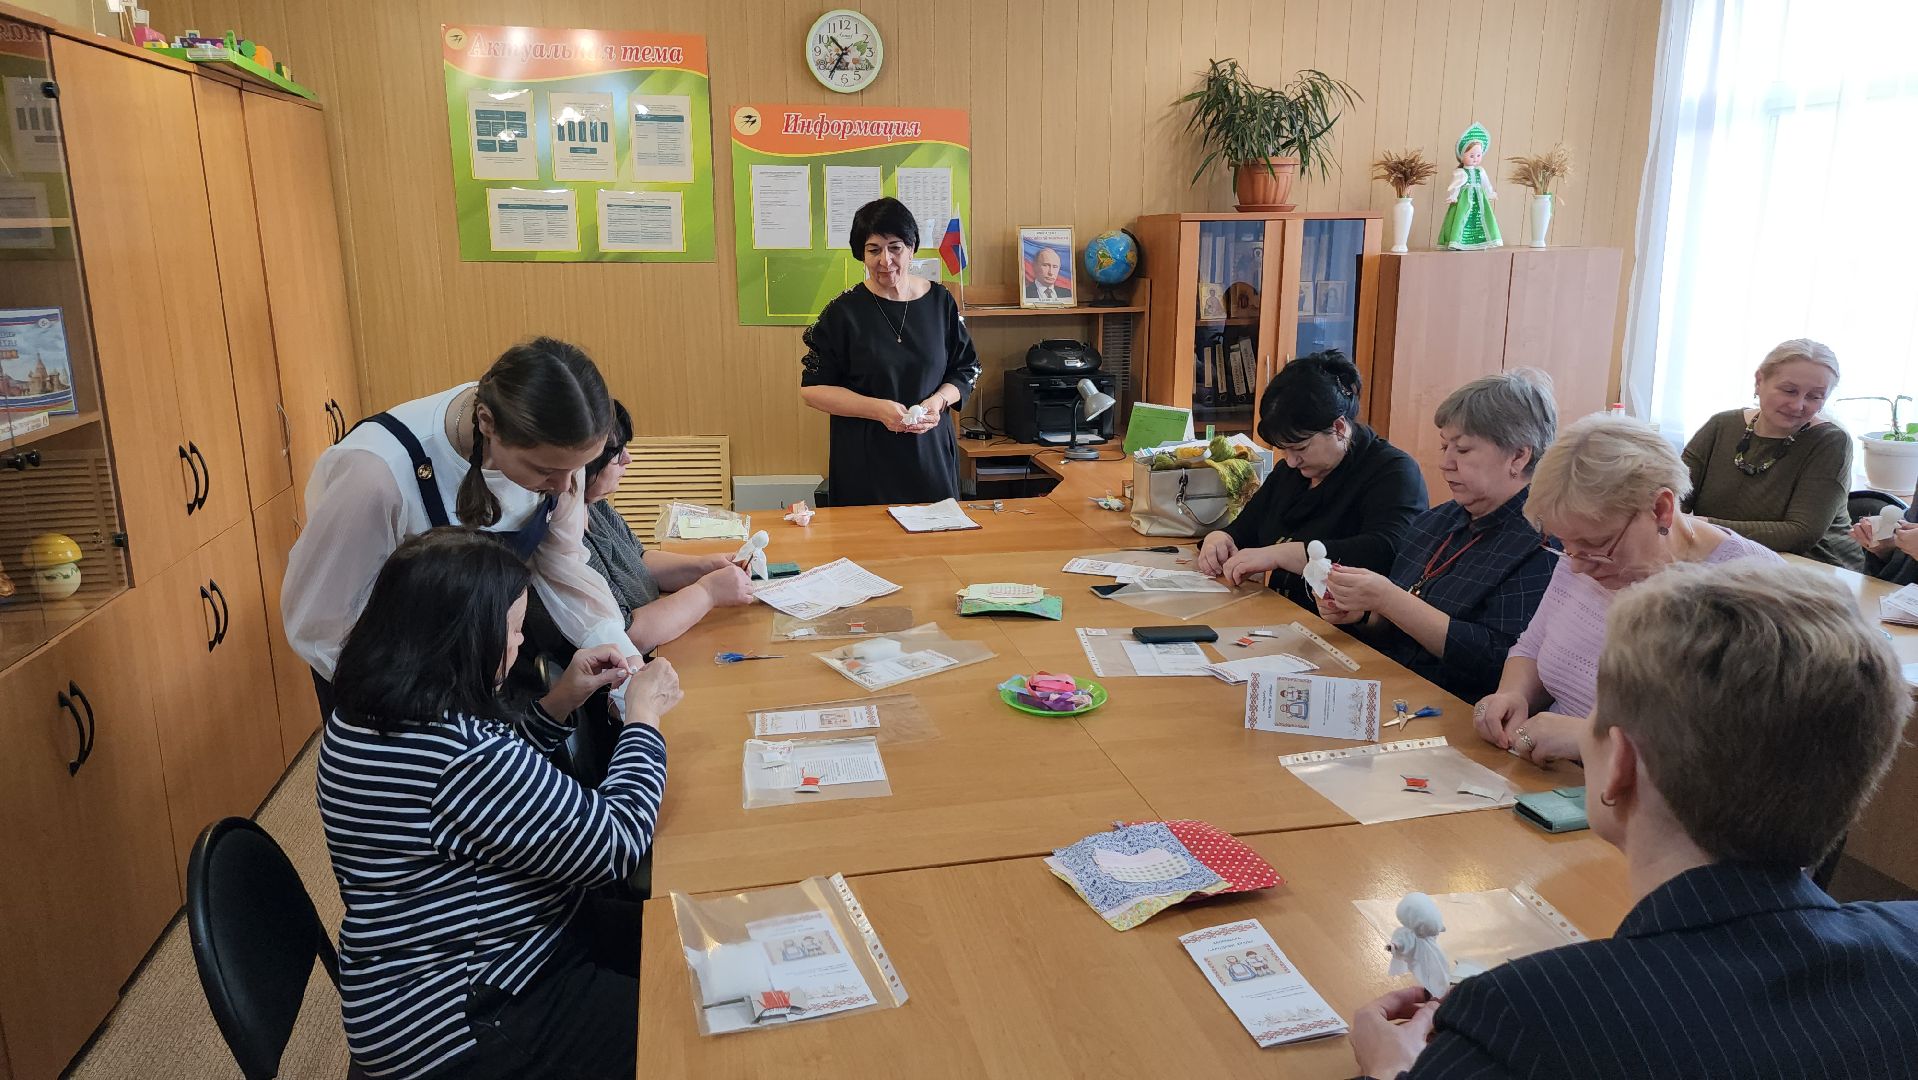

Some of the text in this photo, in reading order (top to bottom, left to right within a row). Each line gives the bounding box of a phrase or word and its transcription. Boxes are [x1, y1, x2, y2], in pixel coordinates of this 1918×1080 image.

[828, 23, 835, 33] 11
[839, 20, 851, 30] 12
[855, 23, 858, 34] 1
[818, 34, 829, 45] 10
[863, 34, 870, 44] 2
[468, 32, 683, 64] Актуалья тема
[814, 46, 821, 56] 9
[866, 47, 874, 58] 3
[819, 60, 827, 70] 8
[841, 74, 848, 84] 6
[853, 70, 861, 80] 5
[782, 112, 921, 141] Информация
